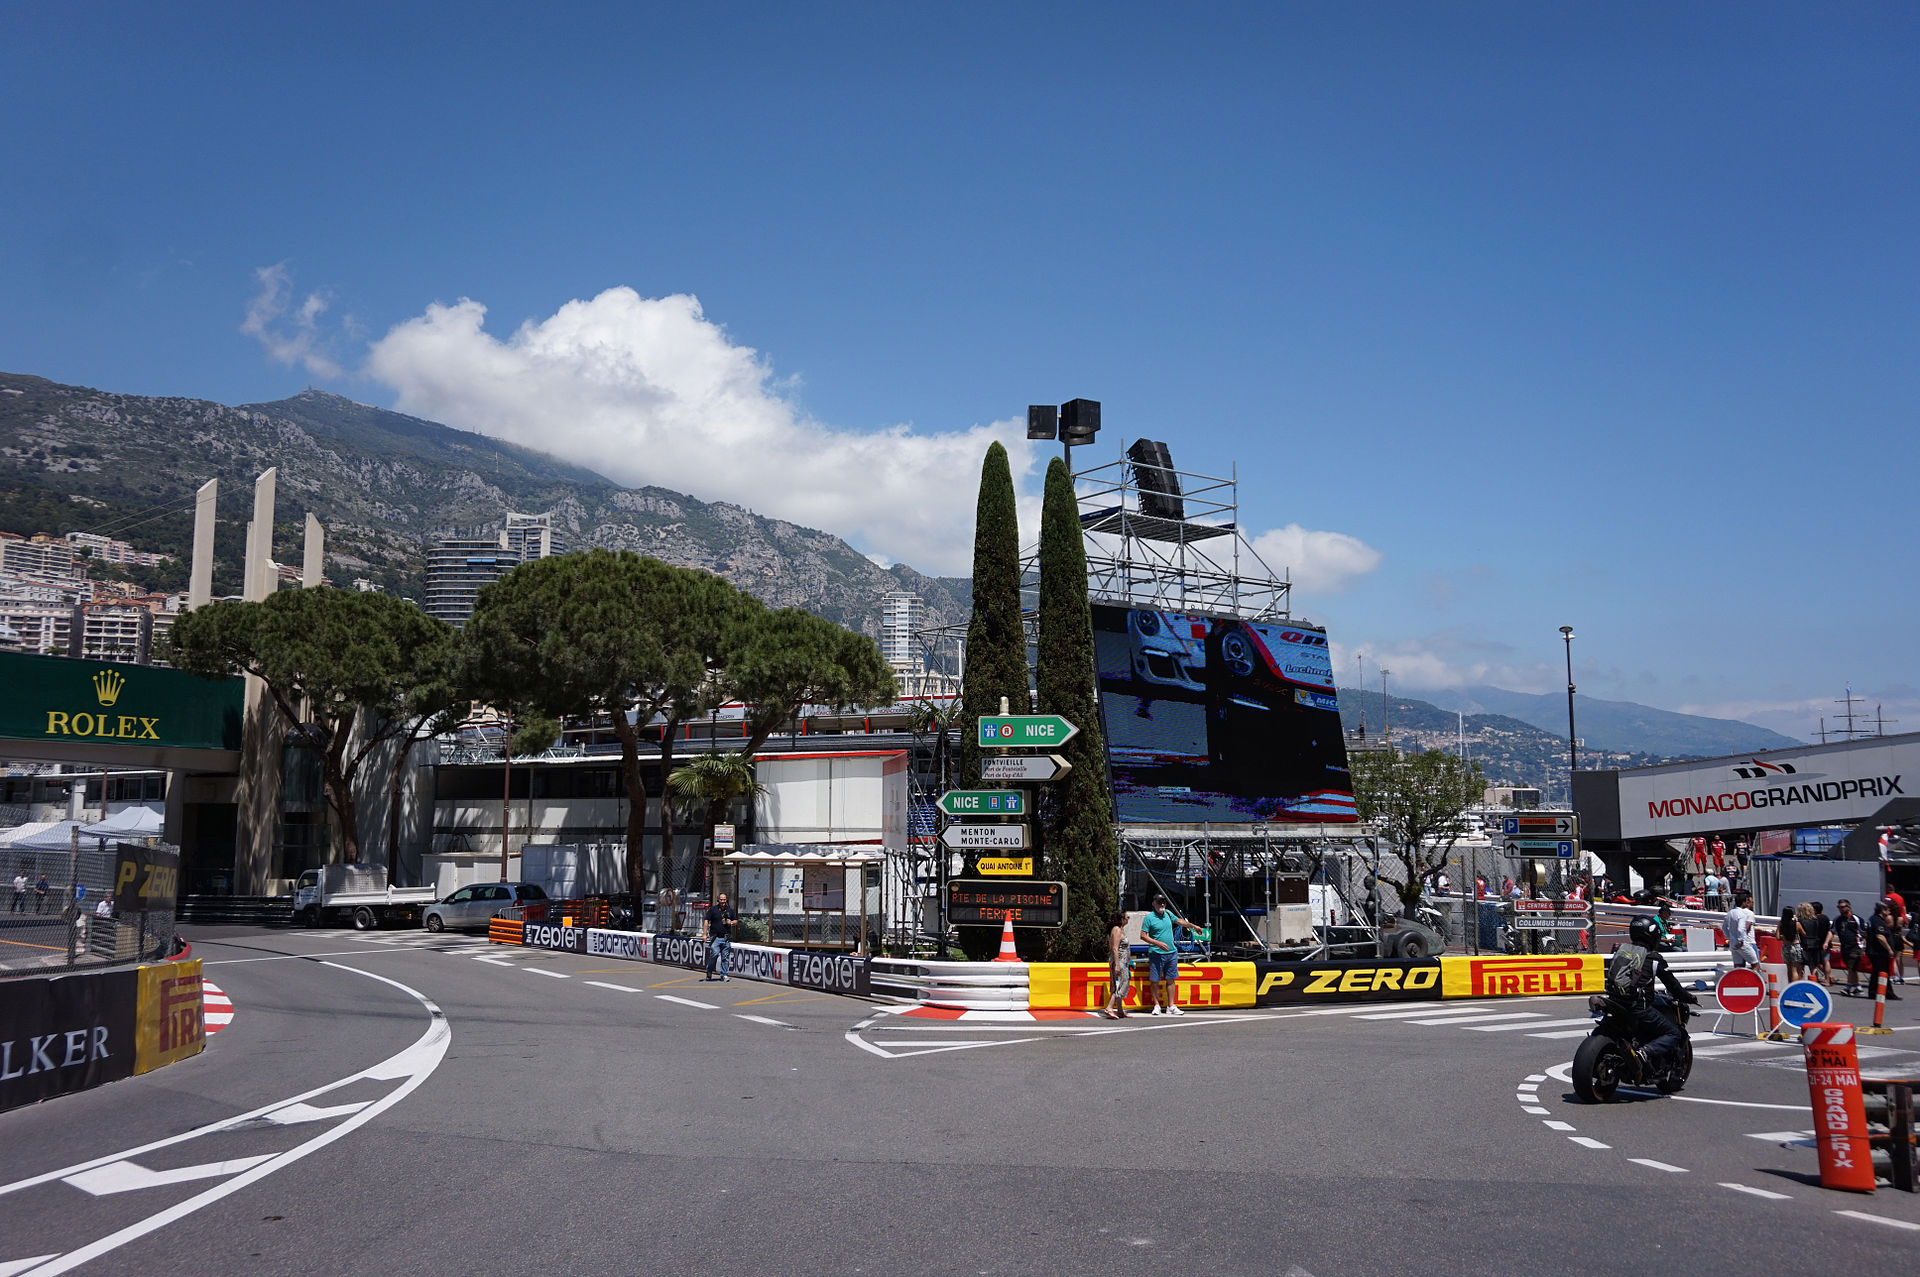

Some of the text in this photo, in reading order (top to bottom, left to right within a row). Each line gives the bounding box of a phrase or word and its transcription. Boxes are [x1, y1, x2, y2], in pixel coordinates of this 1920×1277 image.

[45, 711, 161, 740] ROLEX
[1025, 724, 1055, 737] NICE
[953, 796, 979, 809] NICE
[960, 828, 996, 836] MENTON
[980, 862, 996, 871] QUAI
[998, 862, 1023, 871] ANTOINE
[115, 860, 177, 899] P ZERO
[952, 893, 1053, 905] RTE DE LA PISCINE
[1518, 919, 1575, 927] COLUMBUS Hôtel
[598, 933, 641, 958] BIOPTRON
[1257, 966, 1441, 996] P ZERO
[1470, 957, 1584, 996] PIRELLI
[1822, 1056, 1847, 1067] MAI
[1809, 1074, 1858, 1087] 21-24 MAI
[1823, 1088, 1849, 1131] GRAND
